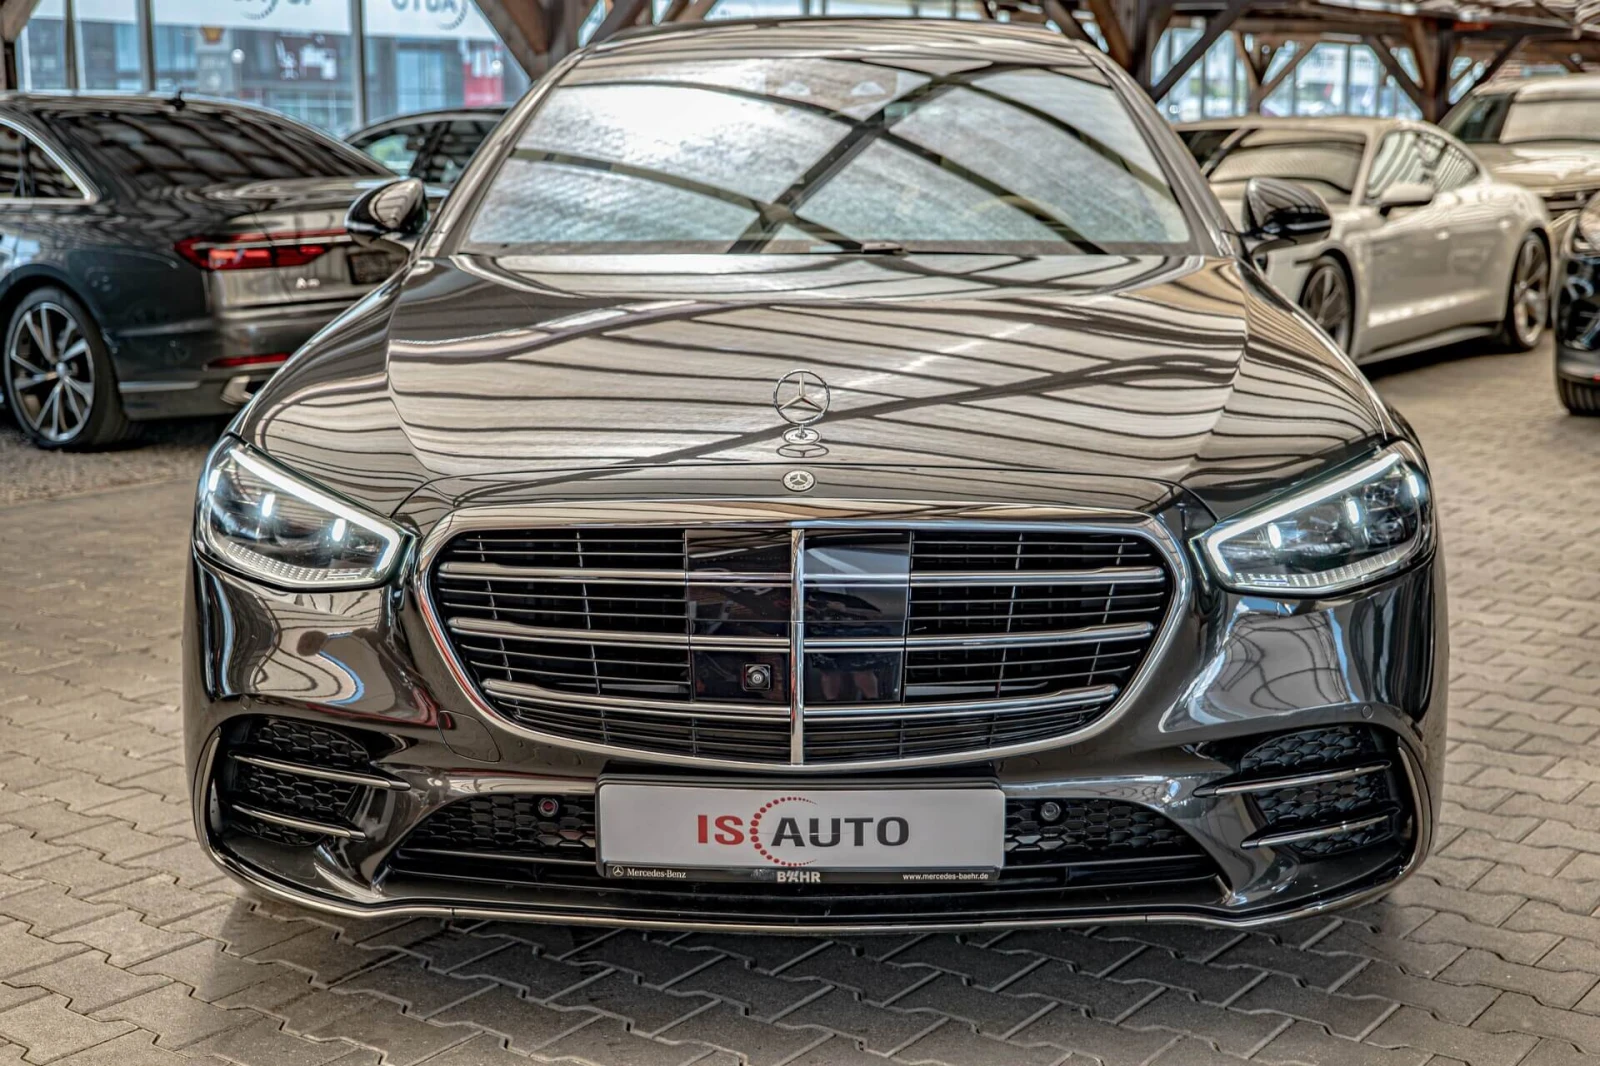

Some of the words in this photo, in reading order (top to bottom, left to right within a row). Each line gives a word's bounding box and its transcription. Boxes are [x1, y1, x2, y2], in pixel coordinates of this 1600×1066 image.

[697, 814, 745, 846] IS
[770, 816, 910, 848] AUTO
[626, 868, 687, 879] Mercedes-Benz
[902, 872, 989, 880] www.mercedes-baehr.de
